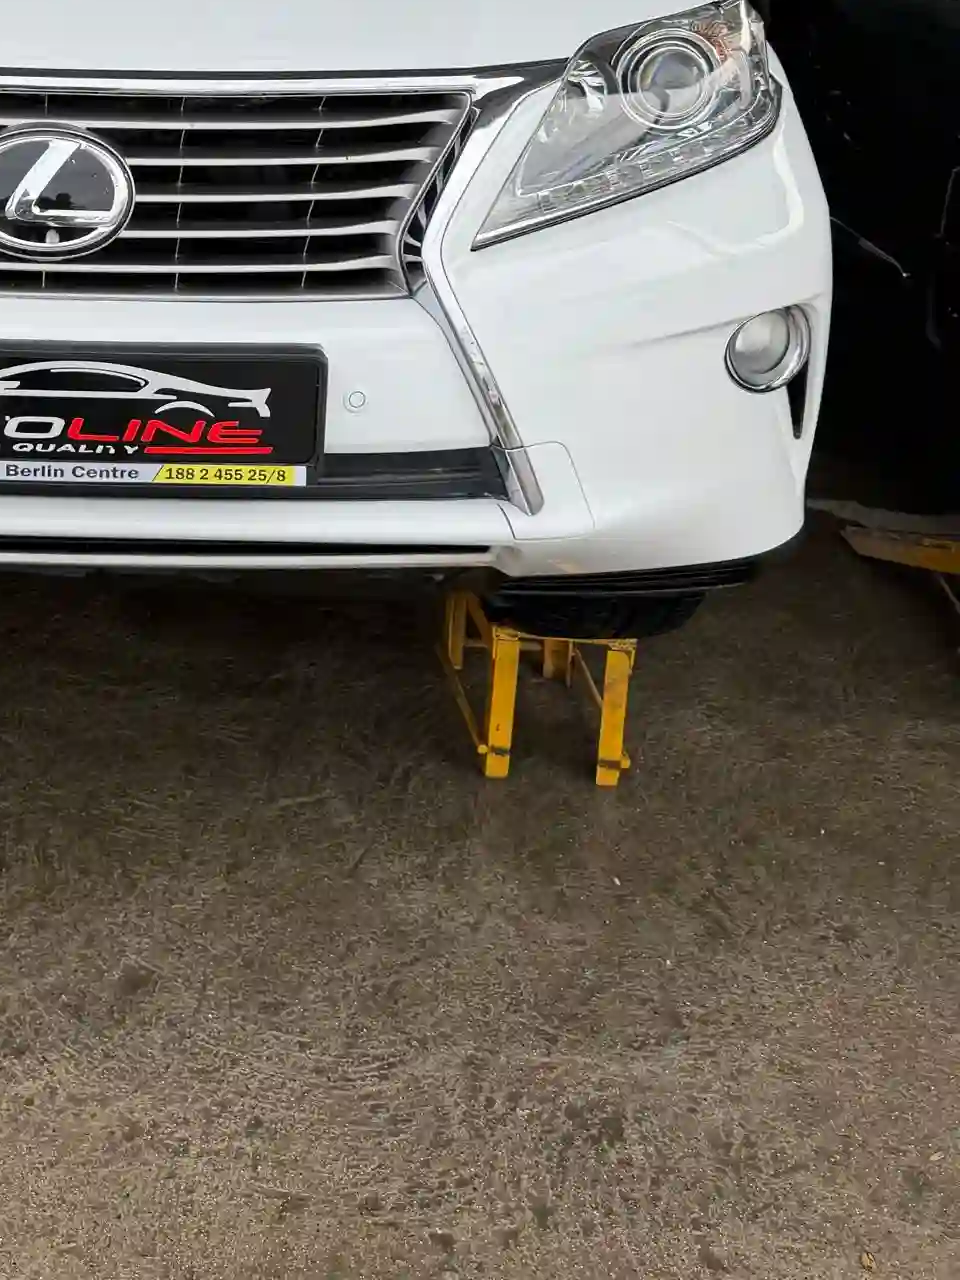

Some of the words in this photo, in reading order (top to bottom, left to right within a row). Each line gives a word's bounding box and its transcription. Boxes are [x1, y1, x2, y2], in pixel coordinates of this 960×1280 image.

[5, 464, 65, 479] Berlin
[71, 466, 139, 480] Centre
[164, 467, 195, 481] 188
[199, 469, 209, 481] 2
[214, 469, 244, 482] 455
[247, 469, 286, 485] 25/8
